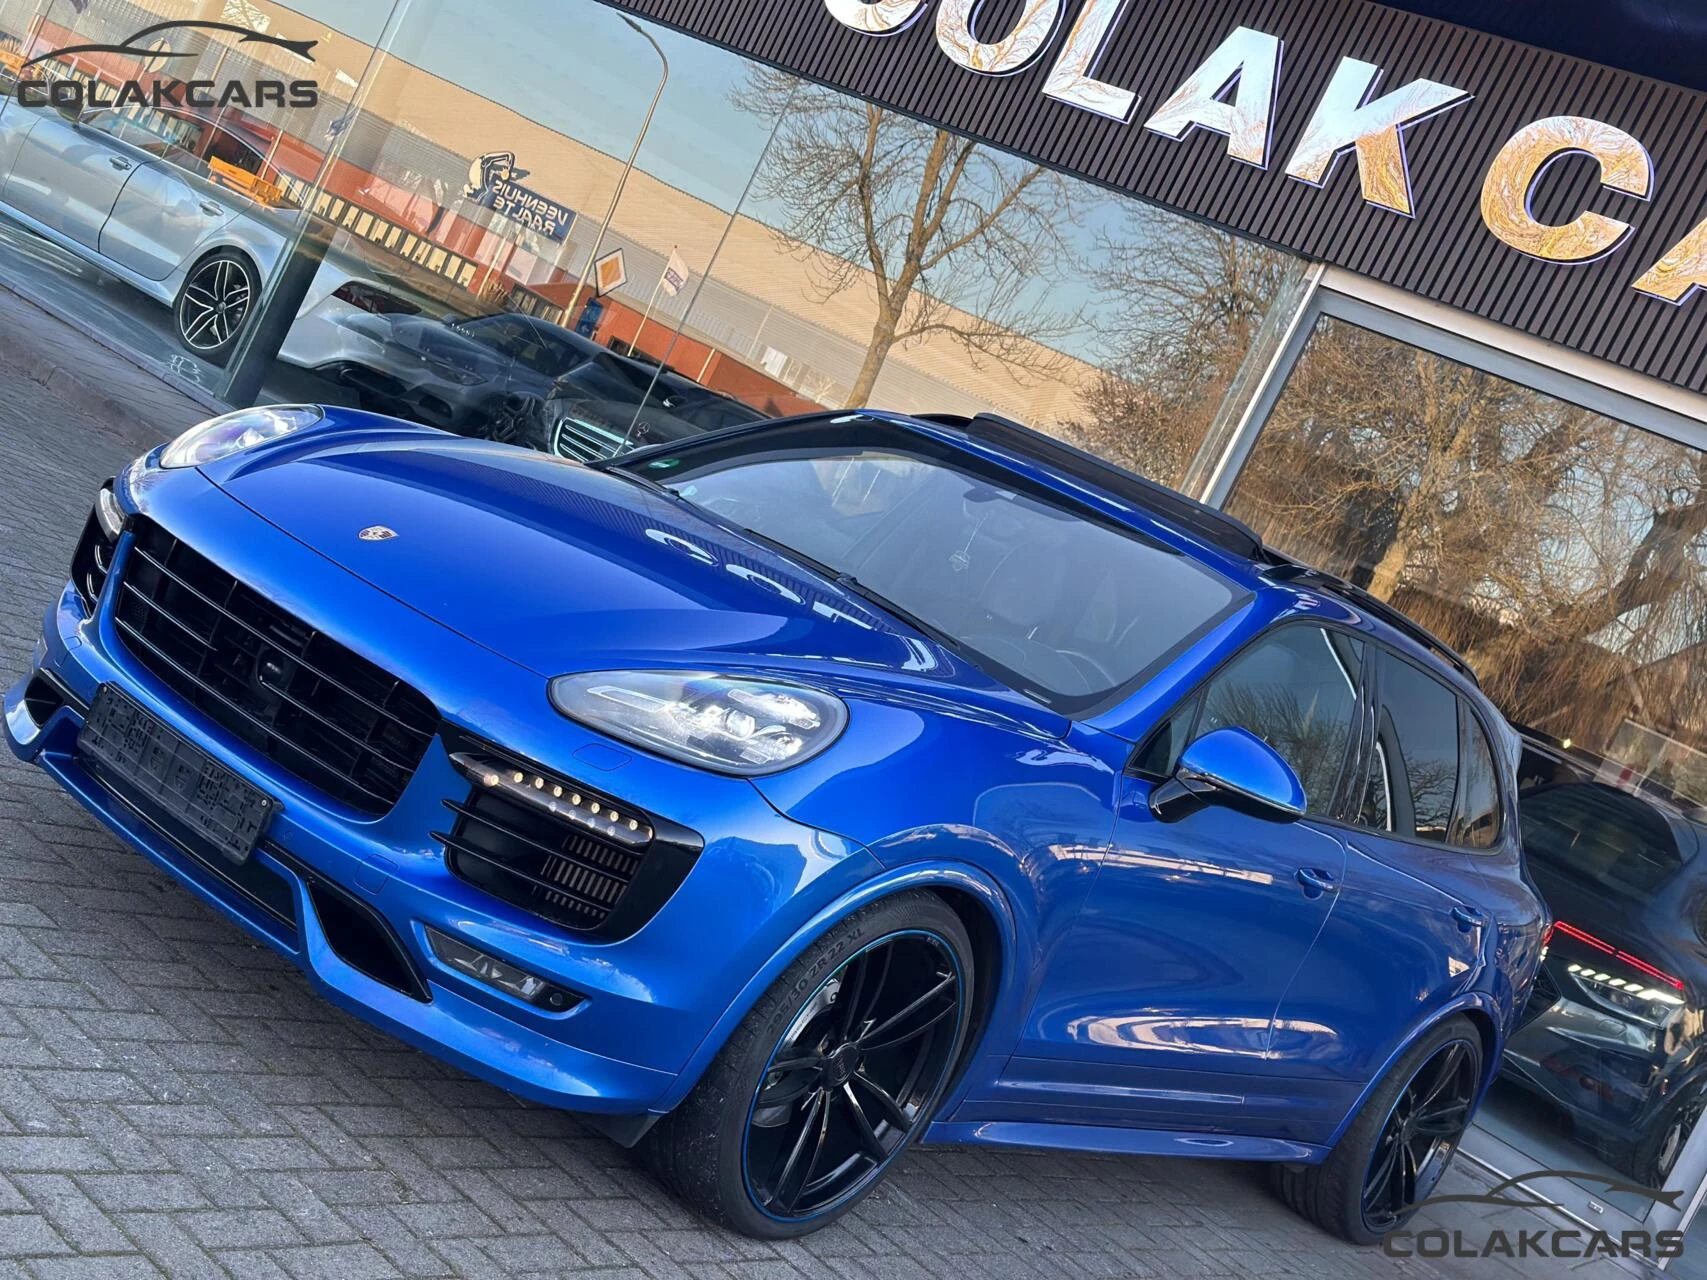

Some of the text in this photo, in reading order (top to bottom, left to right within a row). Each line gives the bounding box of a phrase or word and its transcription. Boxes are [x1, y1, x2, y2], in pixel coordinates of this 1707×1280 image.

[824, 0, 1475, 219] OLAK
[810, 957, 829, 978] ZR
[826, 939, 846, 961] 22
[846, 927, 866, 944] XL
